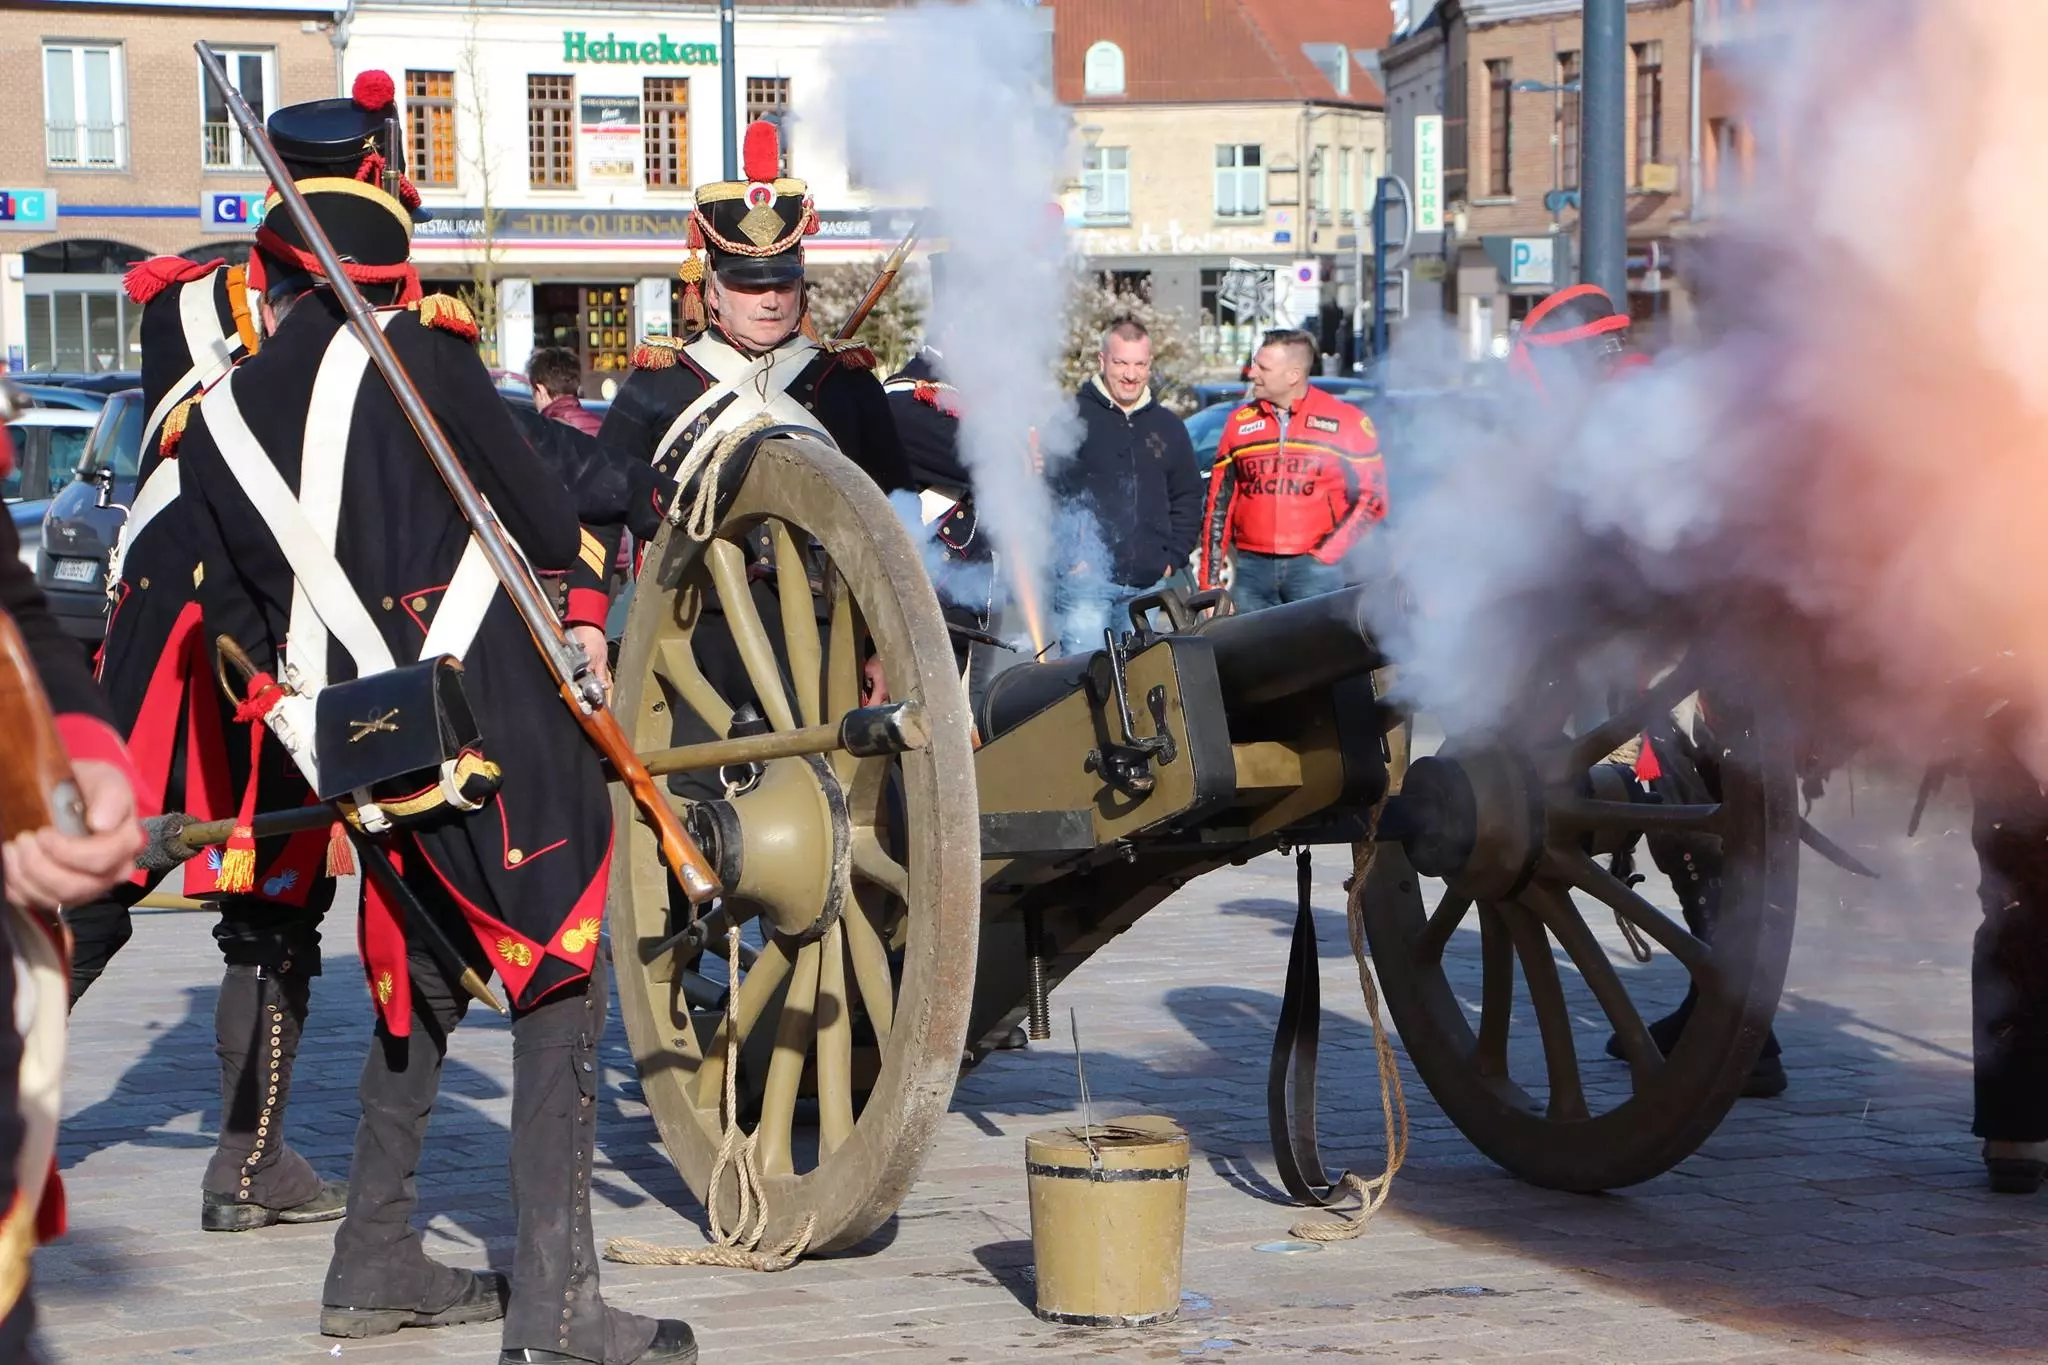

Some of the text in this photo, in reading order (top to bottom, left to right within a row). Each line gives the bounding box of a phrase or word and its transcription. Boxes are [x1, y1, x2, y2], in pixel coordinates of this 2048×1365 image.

[563, 31, 719, 66] Heineken
[1421, 121, 1436, 225] FLEURS
[0, 196, 38, 217] IC
[415, 219, 489, 235] RESTAURAN
[819, 220, 871, 236] RASSERIE
